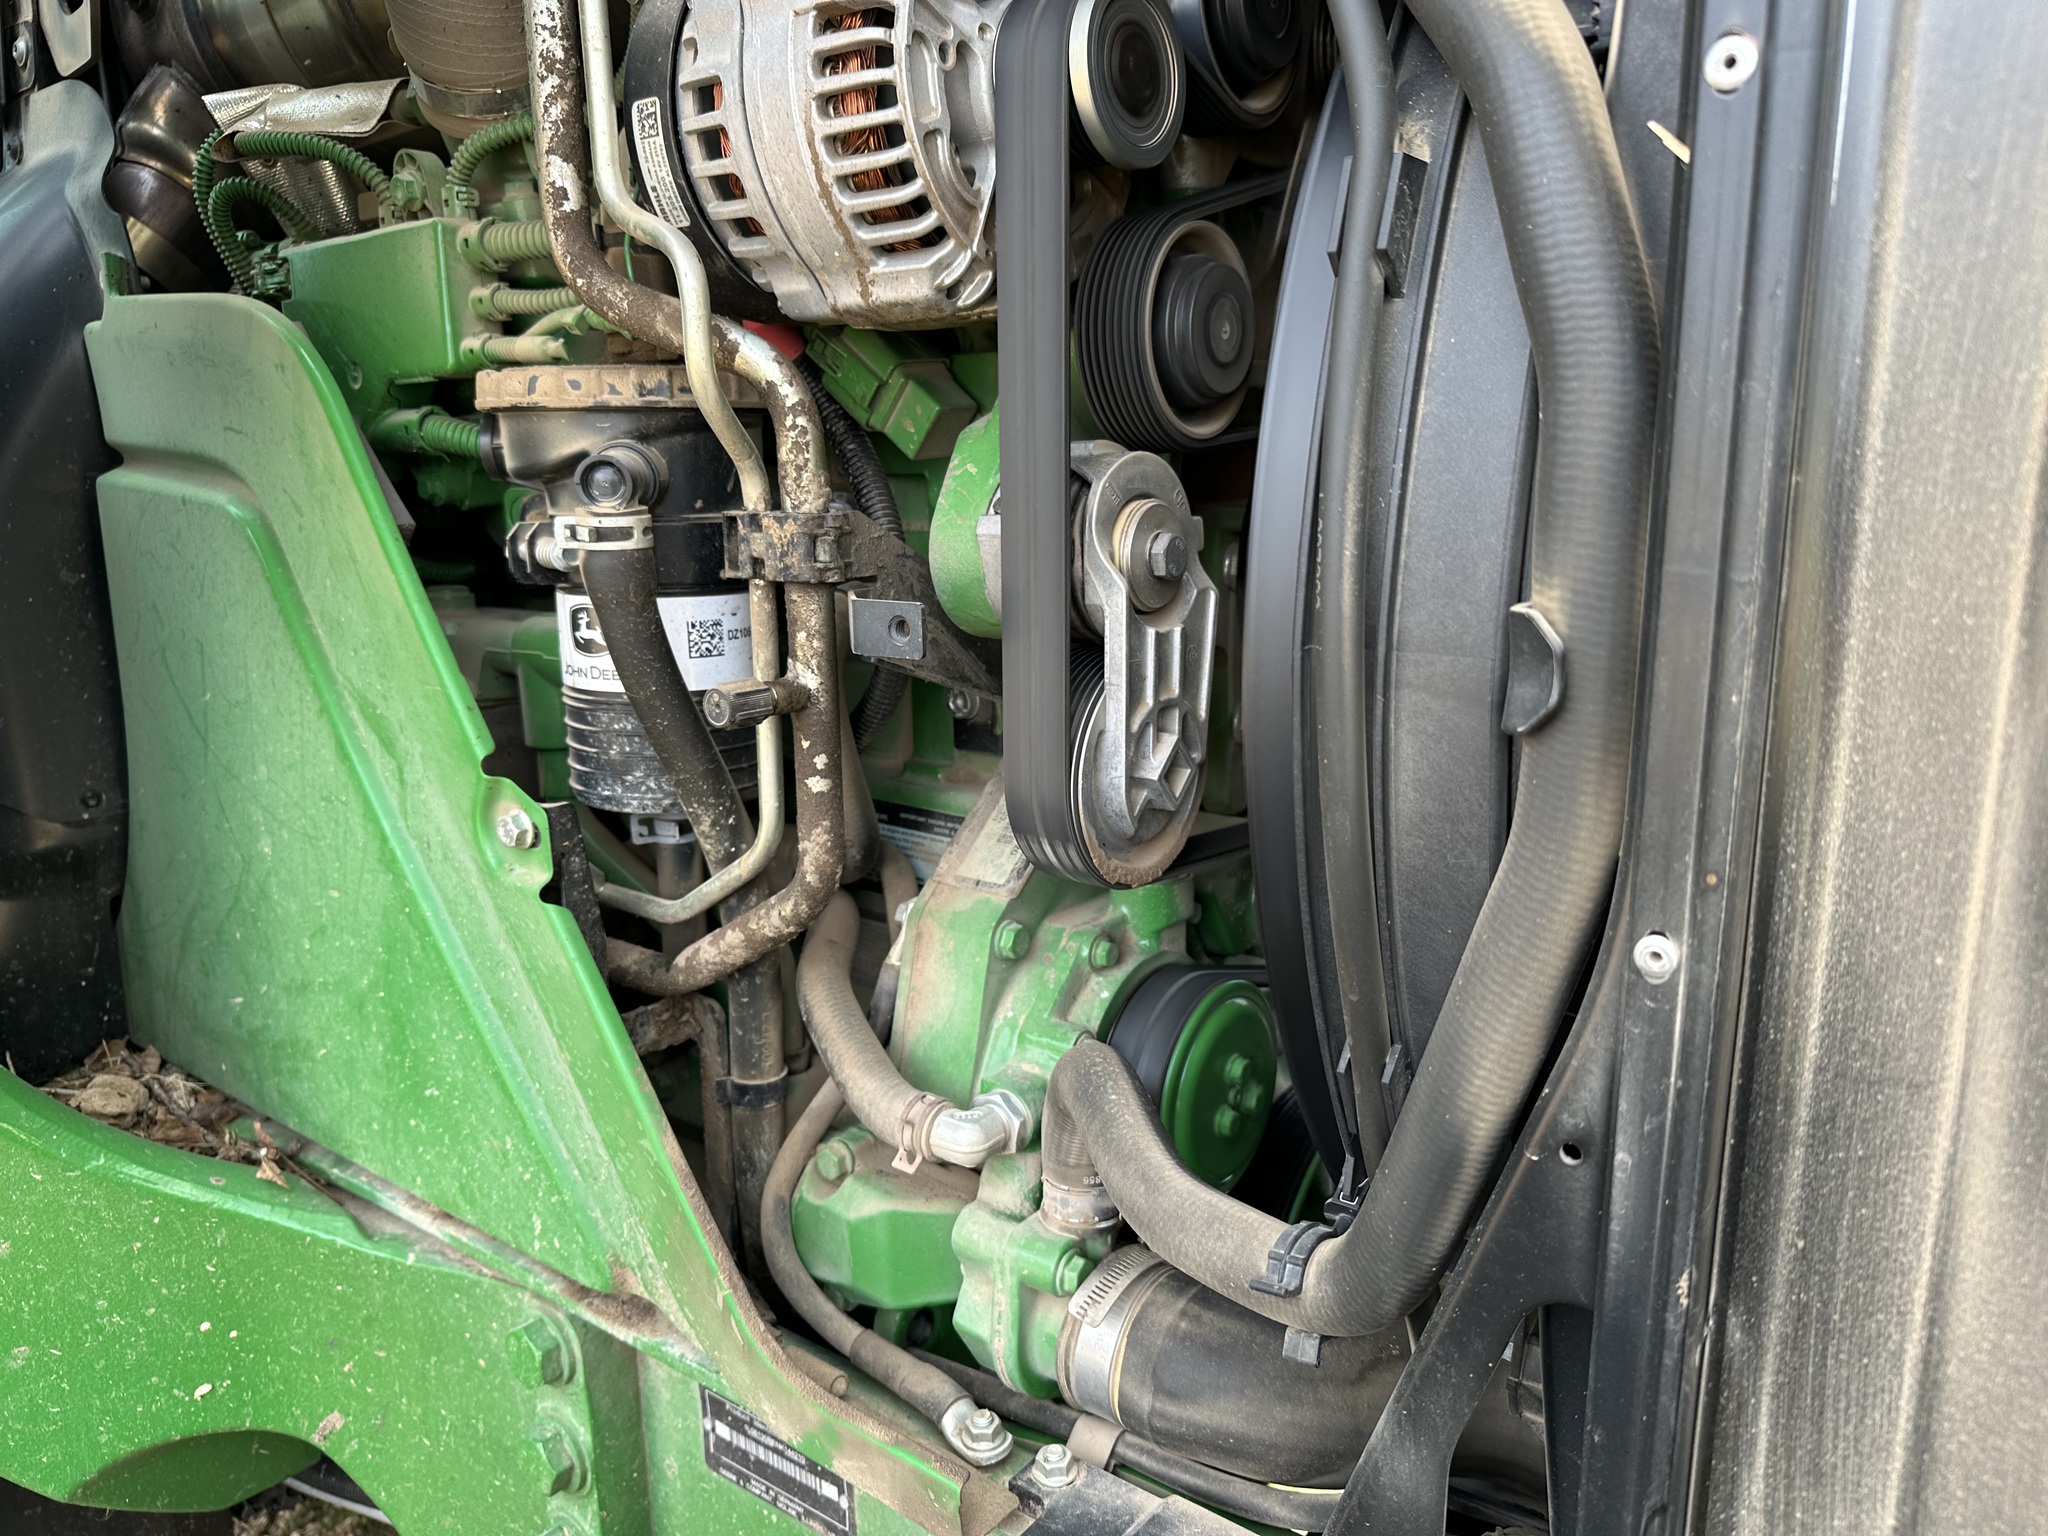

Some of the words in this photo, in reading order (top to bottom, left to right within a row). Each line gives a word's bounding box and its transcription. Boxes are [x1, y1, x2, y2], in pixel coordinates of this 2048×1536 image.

[650, 185, 673, 225] MAHLE
[660, 176, 684, 224] 11.205.200
[668, 180, 680, 204] DEERE
[565, 661, 589, 680] JOHN
[590, 665, 621, 682] DEE
